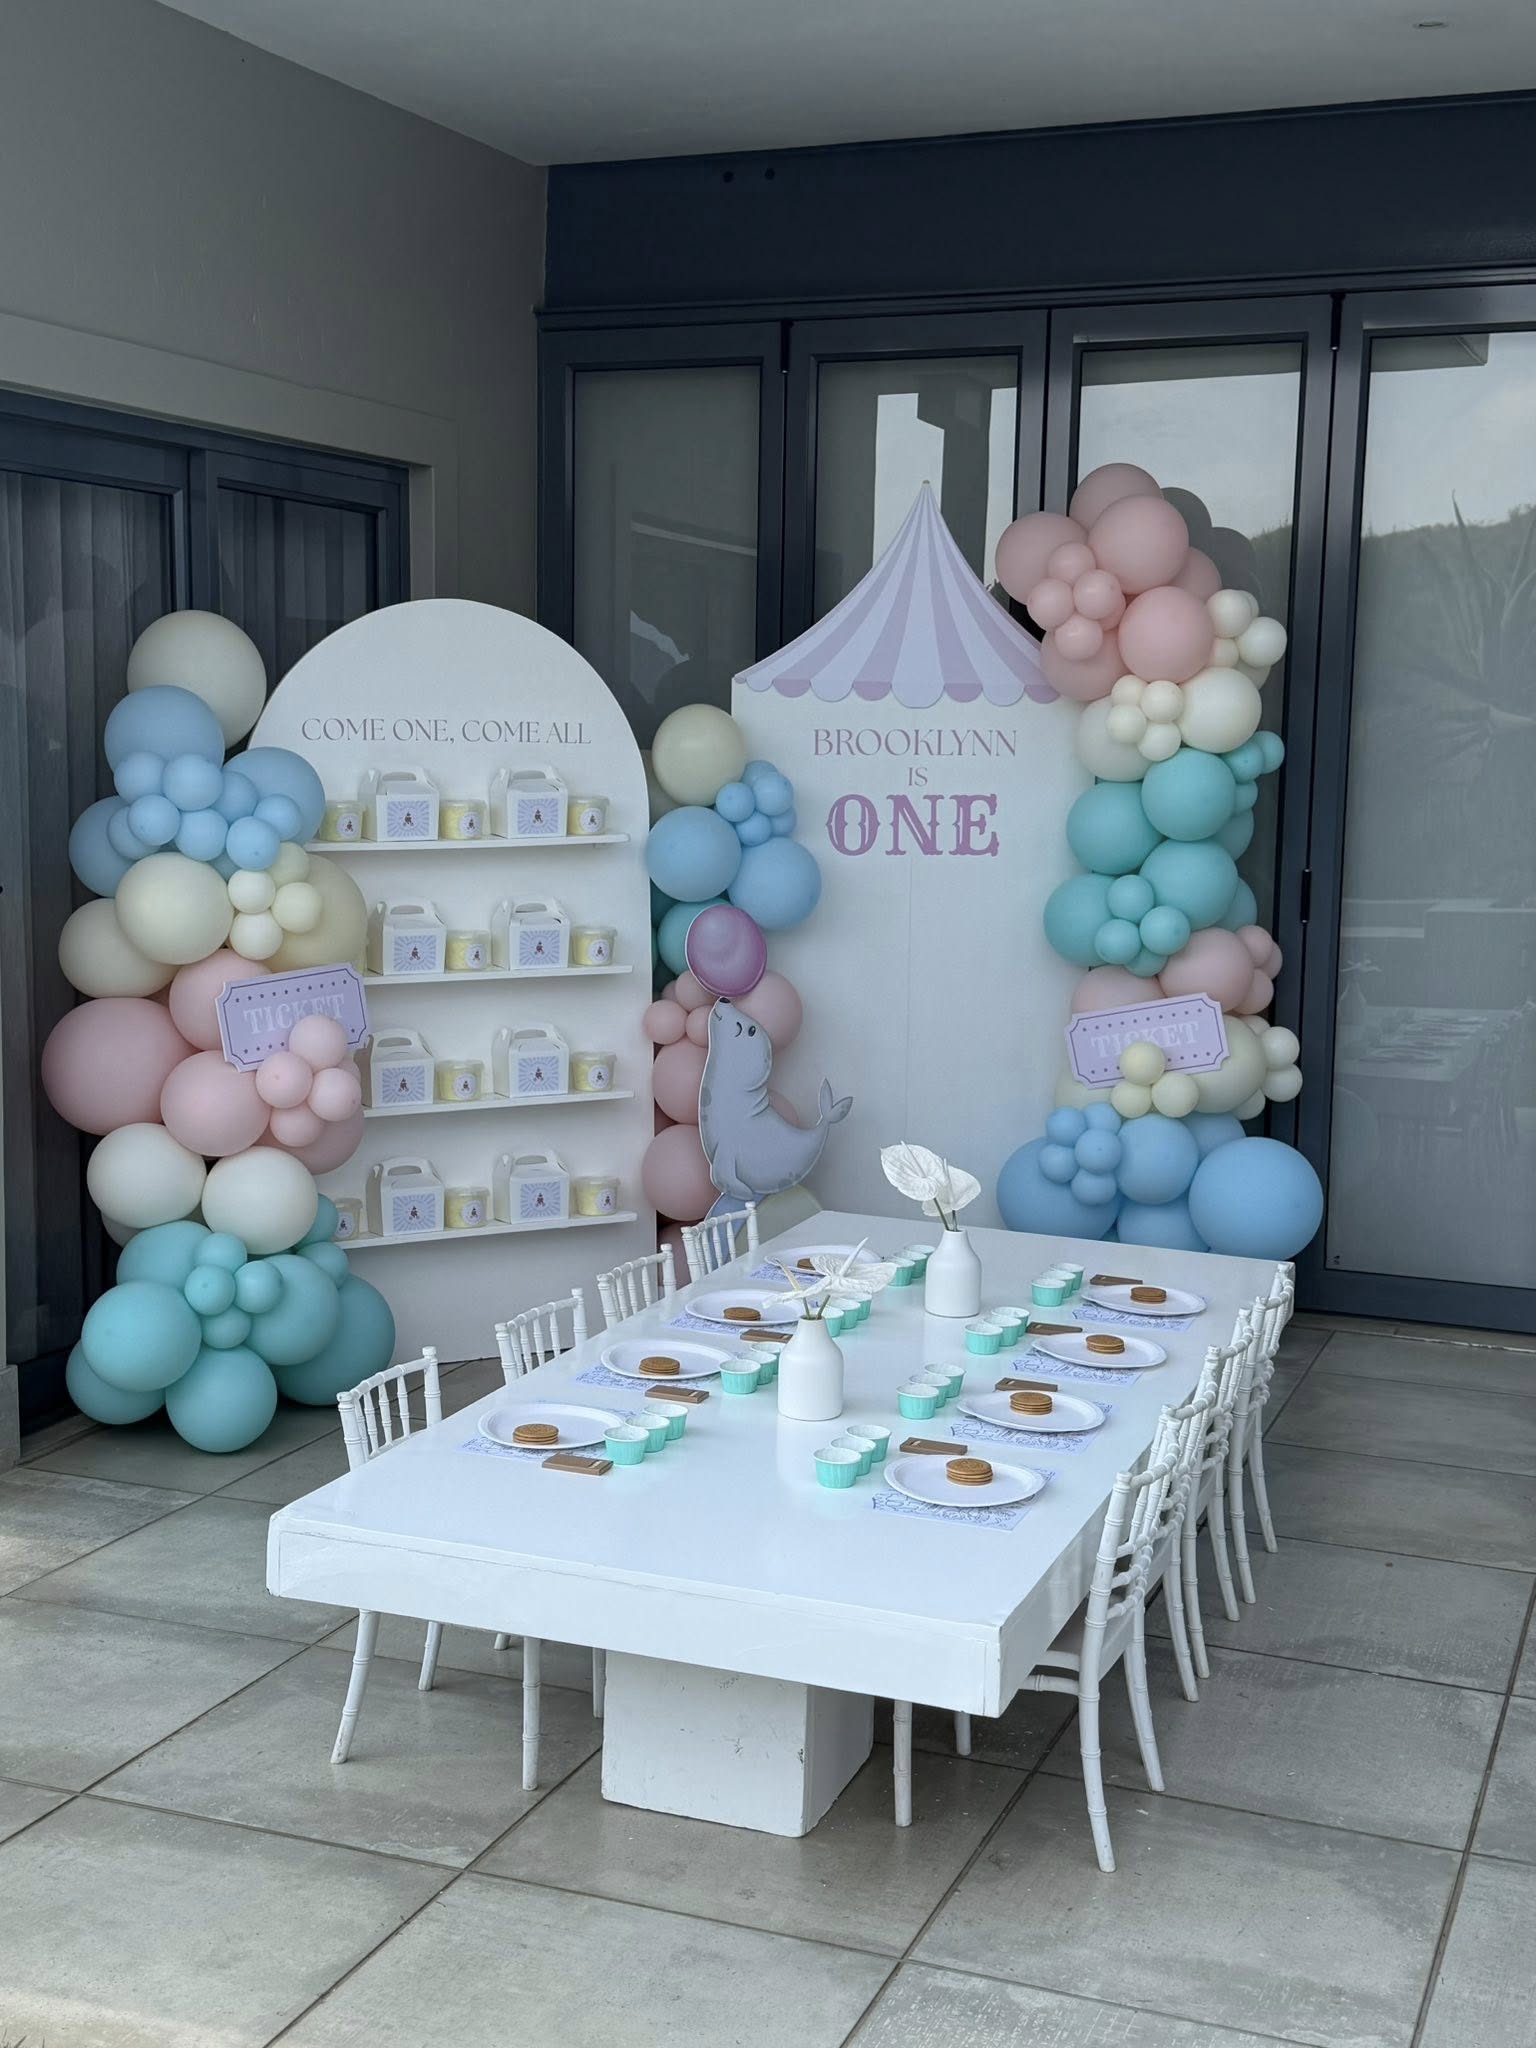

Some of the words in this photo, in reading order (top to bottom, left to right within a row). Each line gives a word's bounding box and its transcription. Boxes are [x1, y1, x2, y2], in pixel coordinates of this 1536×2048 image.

[301, 718, 386, 741] COME
[392, 718, 455, 744] ONE,
[461, 720, 540, 743] COME
[546, 722, 592, 745] ALL
[813, 728, 1017, 757] BROOKLYNN
[908, 767, 928, 786] IS
[825, 793, 1000, 857] ONE
